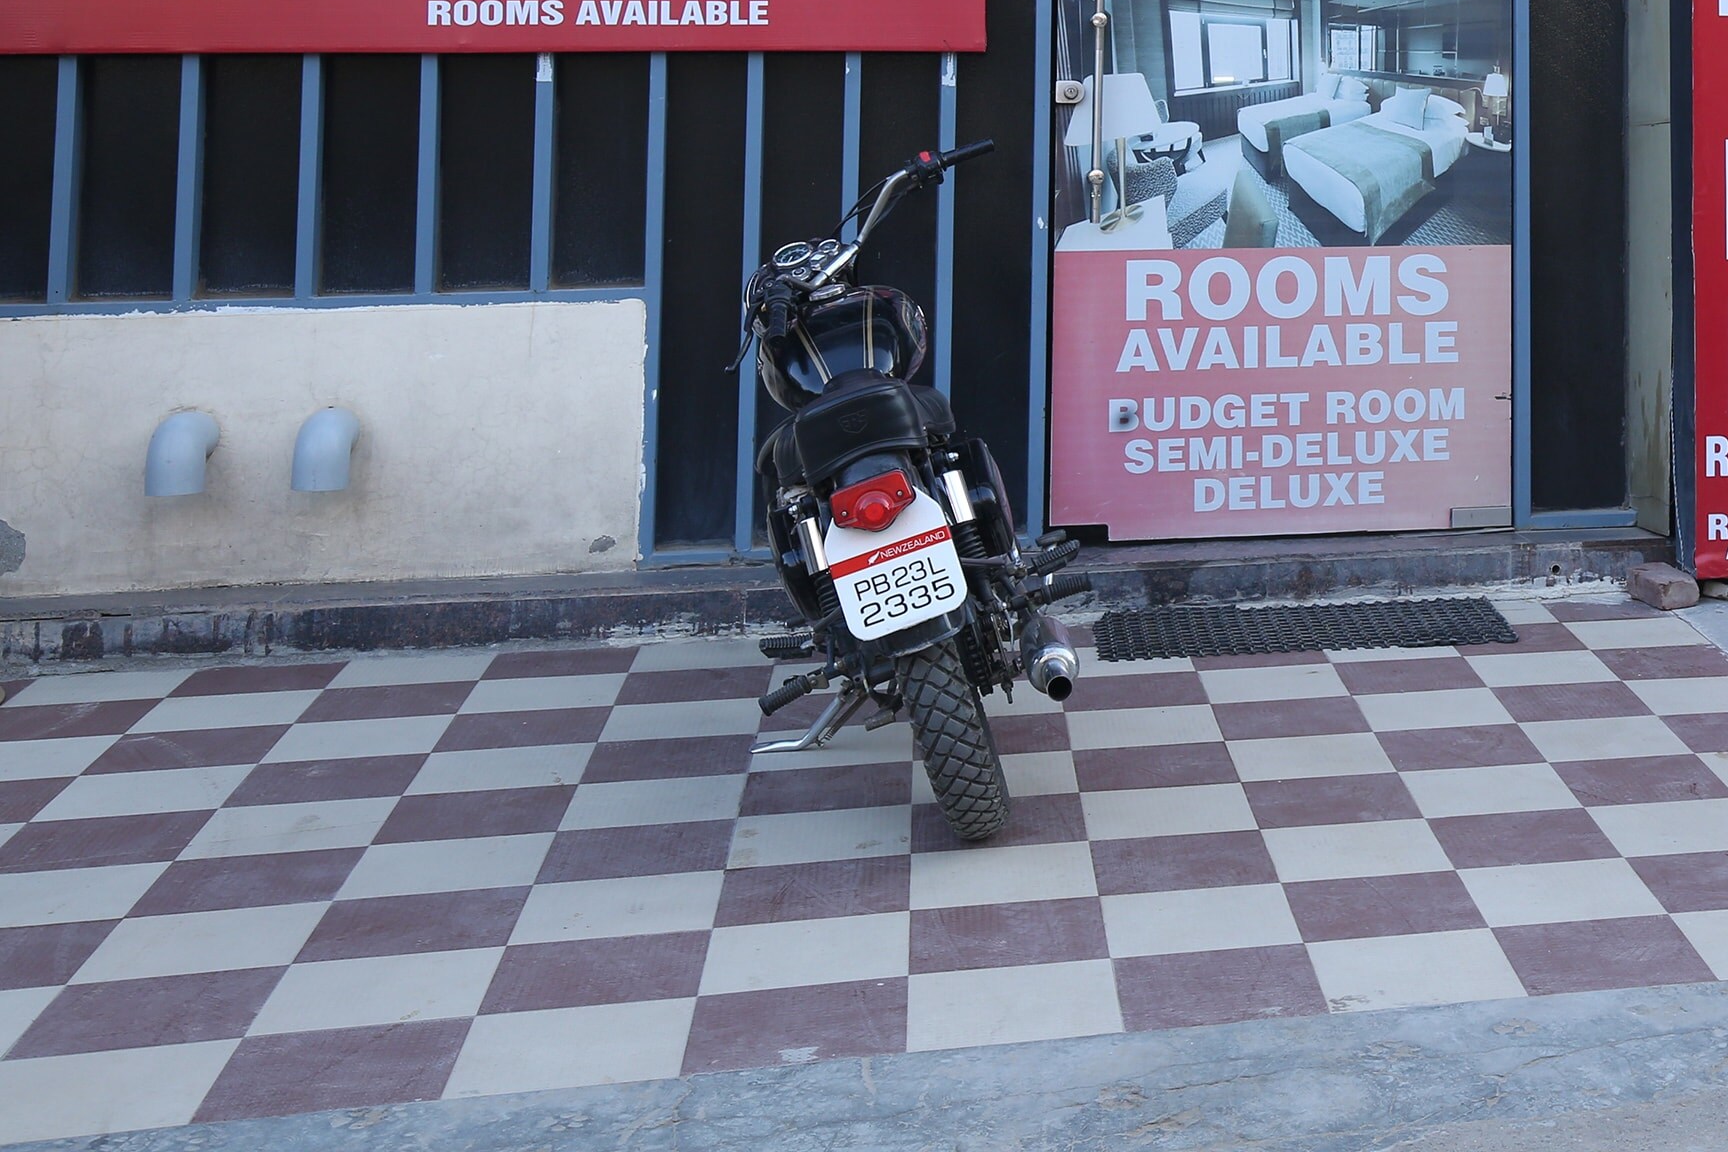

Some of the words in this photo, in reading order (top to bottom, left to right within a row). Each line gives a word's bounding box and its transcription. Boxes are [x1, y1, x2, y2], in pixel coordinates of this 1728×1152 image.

[428, 0, 563, 25] ROOMS
[576, 1, 768, 25] AVAILABLE
[1126, 254, 1449, 321] ROOMS
[1116, 321, 1459, 372] AVAILABLE
[1109, 393, 1309, 433] BUDGET
[1327, 388, 1464, 424] ROOM
[1124, 428, 1450, 474] SEMI-DELUXE
[1193, 471, 1384, 512] DELUXE
[880, 531, 945, 558] NEWZEALAND
[854, 557, 946, 601] PB23L
[860, 577, 955, 627] 2335
